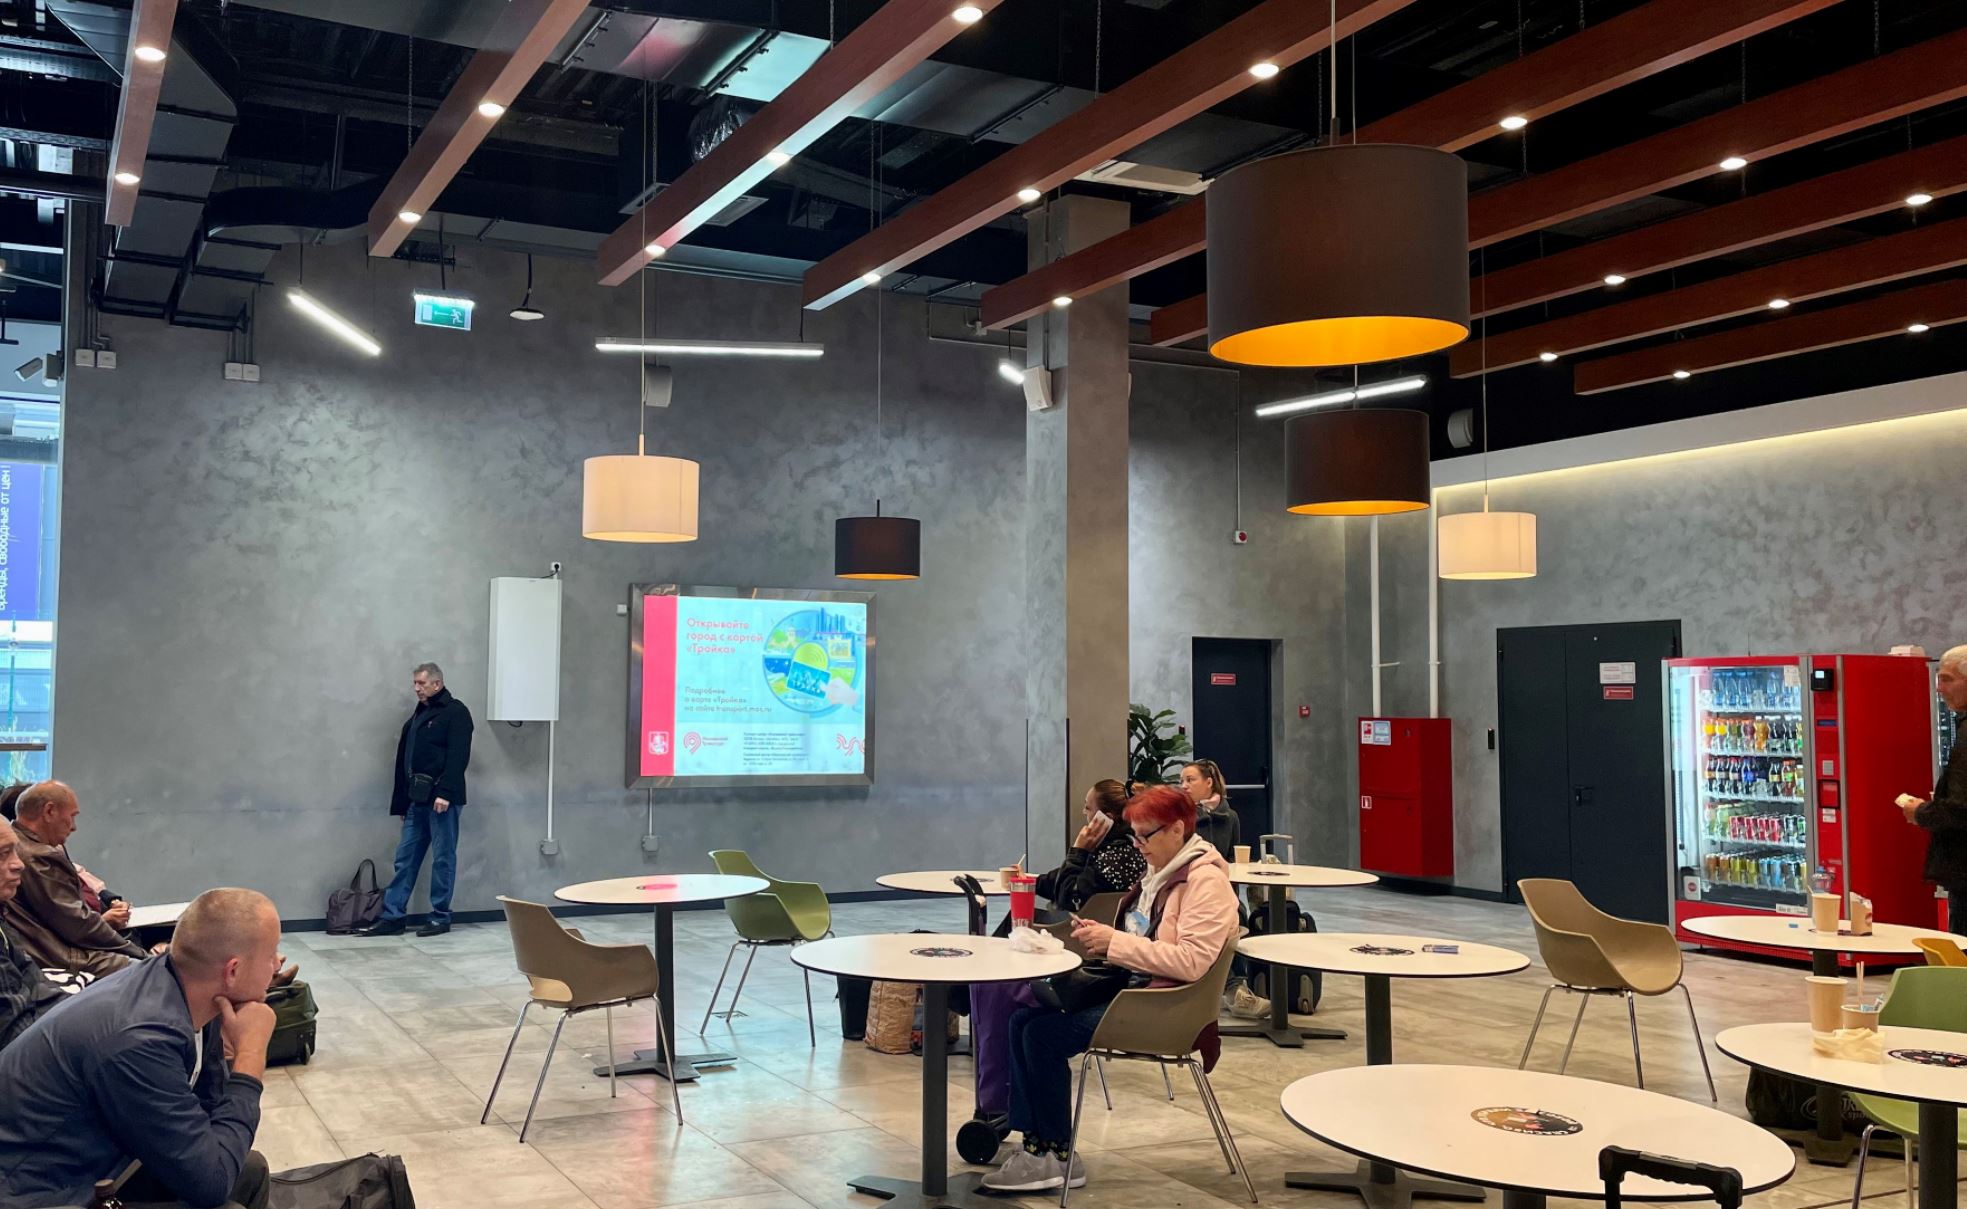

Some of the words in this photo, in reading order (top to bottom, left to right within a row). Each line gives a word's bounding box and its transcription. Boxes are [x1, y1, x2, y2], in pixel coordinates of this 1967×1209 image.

[0, 492, 10, 505] от
[687, 617, 750, 630] Открывайте
[686, 632, 718, 642] город
[726, 632, 764, 644] картой
